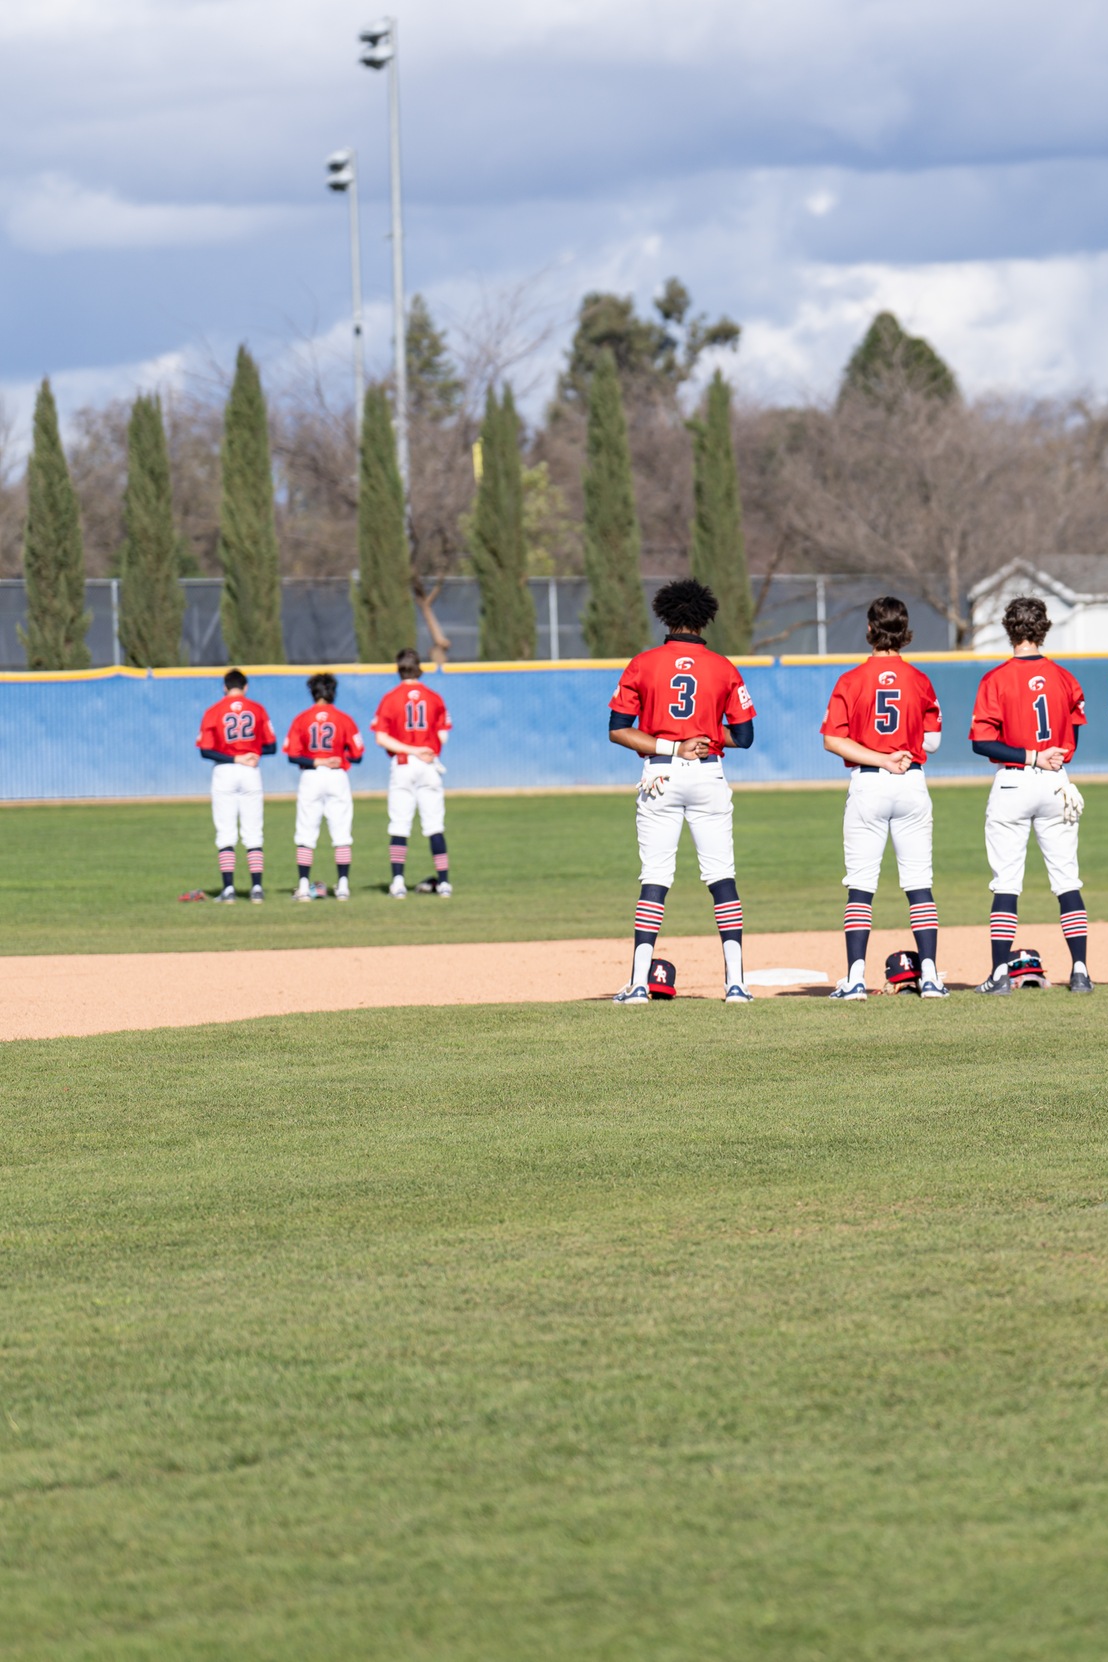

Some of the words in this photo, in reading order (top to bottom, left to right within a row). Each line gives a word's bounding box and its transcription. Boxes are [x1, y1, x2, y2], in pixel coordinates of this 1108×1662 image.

[405, 700, 427, 731] 11
[668, 674, 697, 720] 3
[874, 689, 901, 735] 5
[223, 711, 256, 743] 22
[308, 722, 336, 751] 12
[1032, 694, 1052, 743] 1
